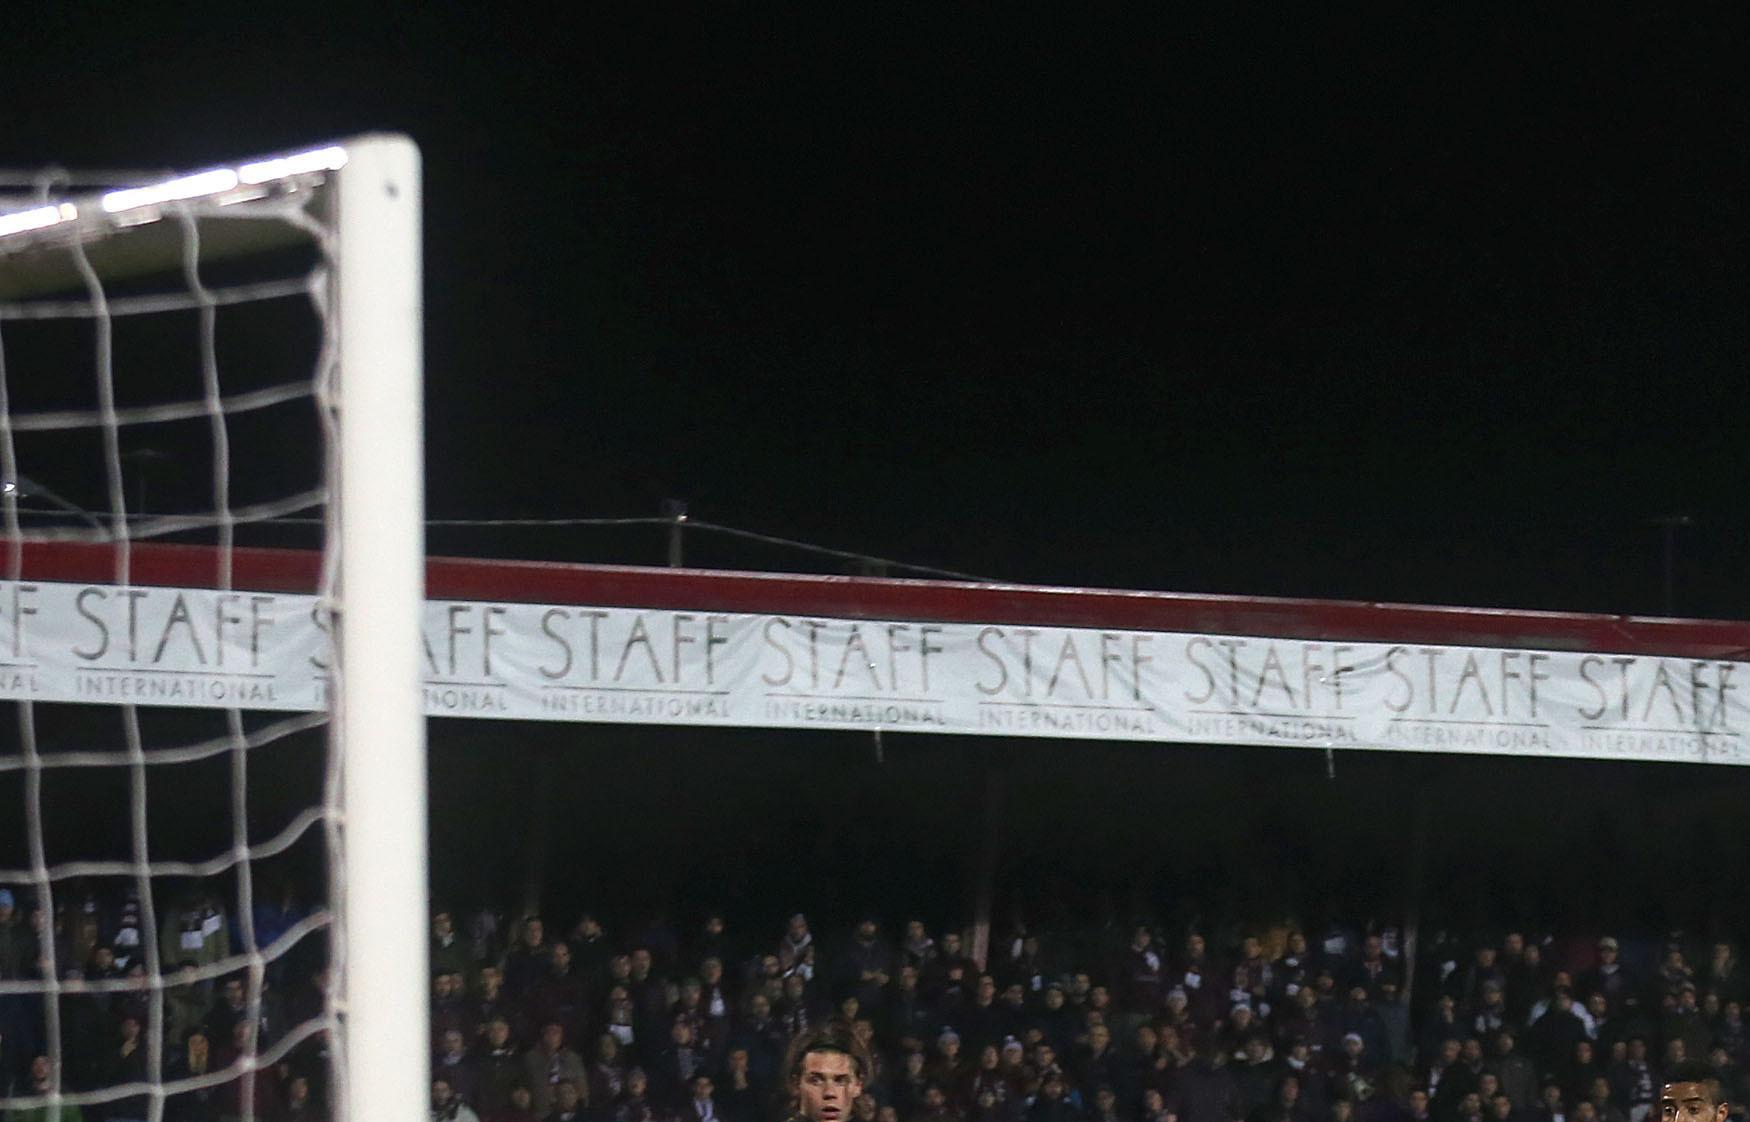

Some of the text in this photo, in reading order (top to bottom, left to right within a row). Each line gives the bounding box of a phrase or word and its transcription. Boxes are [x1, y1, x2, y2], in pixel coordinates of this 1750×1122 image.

[72, 585, 275, 666] STAFF
[538, 607, 731, 685] STAFF
[762, 616, 944, 690] STAFF
[976, 626, 1154, 701] STAFF
[1186, 637, 1357, 710] STAFF
[1385, 646, 1549, 719] STAFF
[1579, 656, 1739, 732] STAFF
[76, 675, 276, 702] INTERNATIONAL
[766, 701, 945, 726] INTERNATIONAL
[979, 708, 1154, 735] INTERNATIONAL
